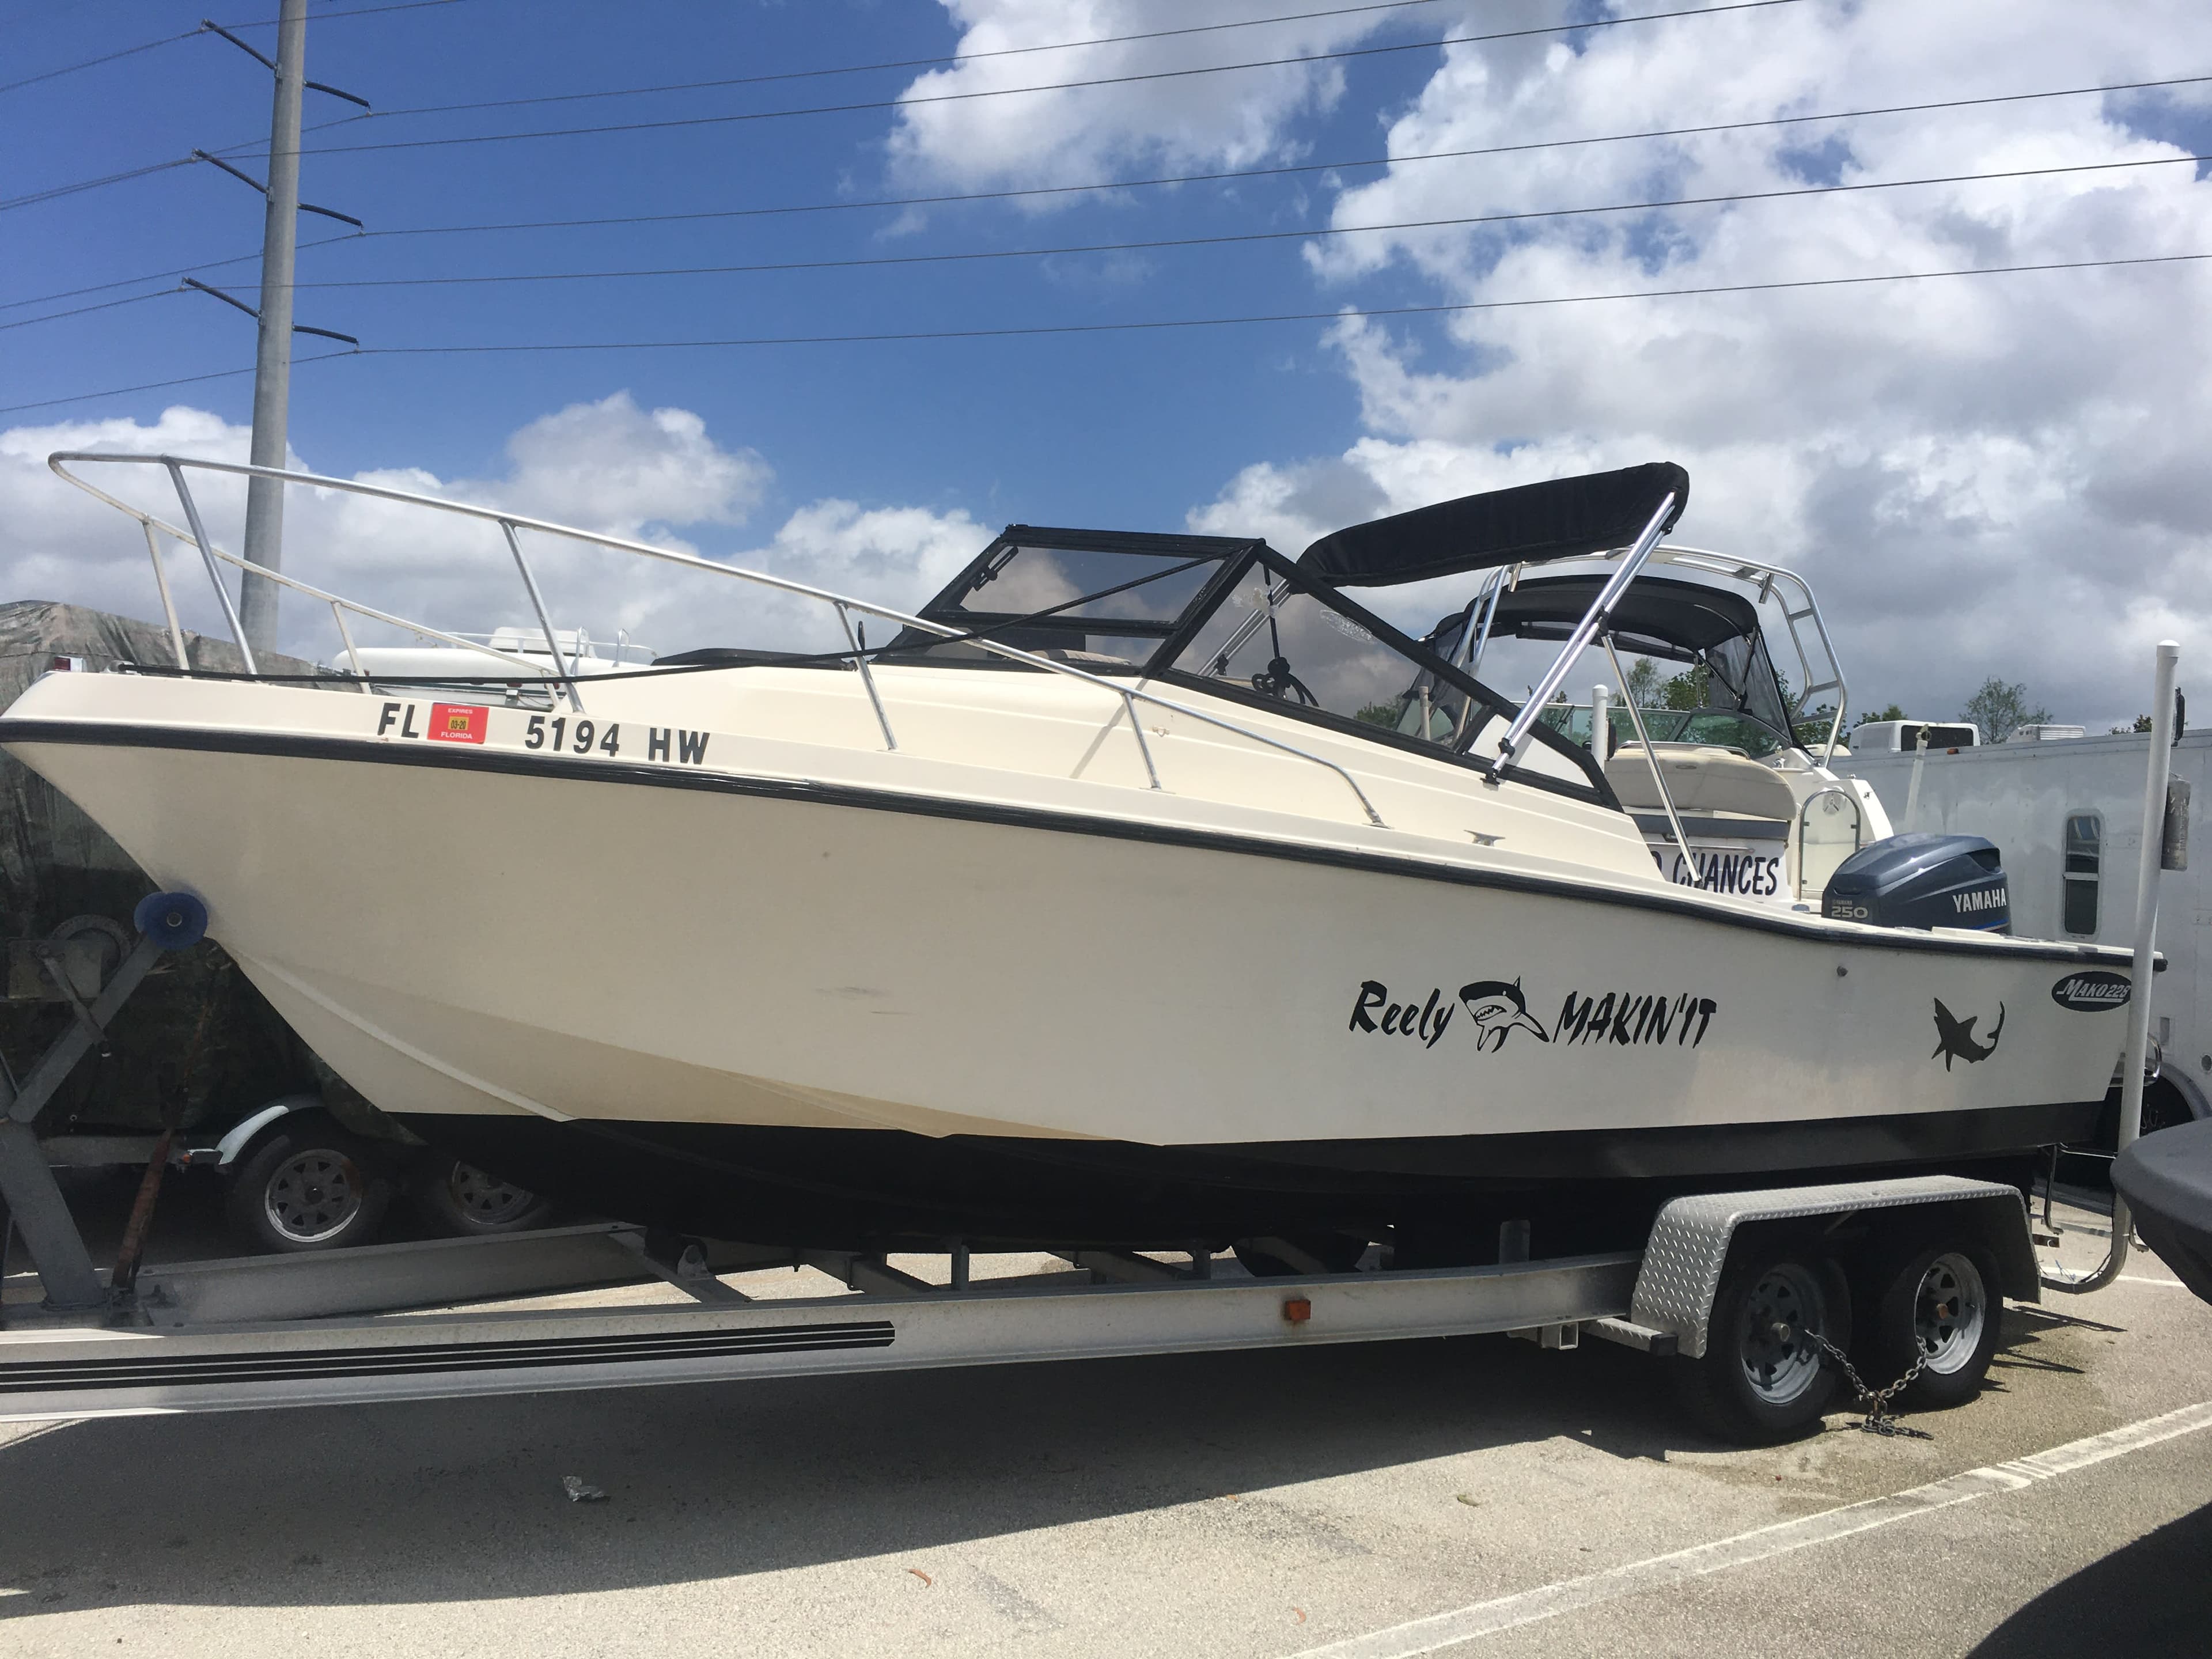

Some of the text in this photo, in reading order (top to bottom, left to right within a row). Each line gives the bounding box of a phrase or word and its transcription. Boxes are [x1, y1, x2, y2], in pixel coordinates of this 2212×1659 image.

[377, 702, 710, 765] FL 5194 HW
[1831, 906, 1868, 919] 250
[1952, 888, 2007, 913] YAMAHA
[1349, 980, 1455, 1049] Reely
